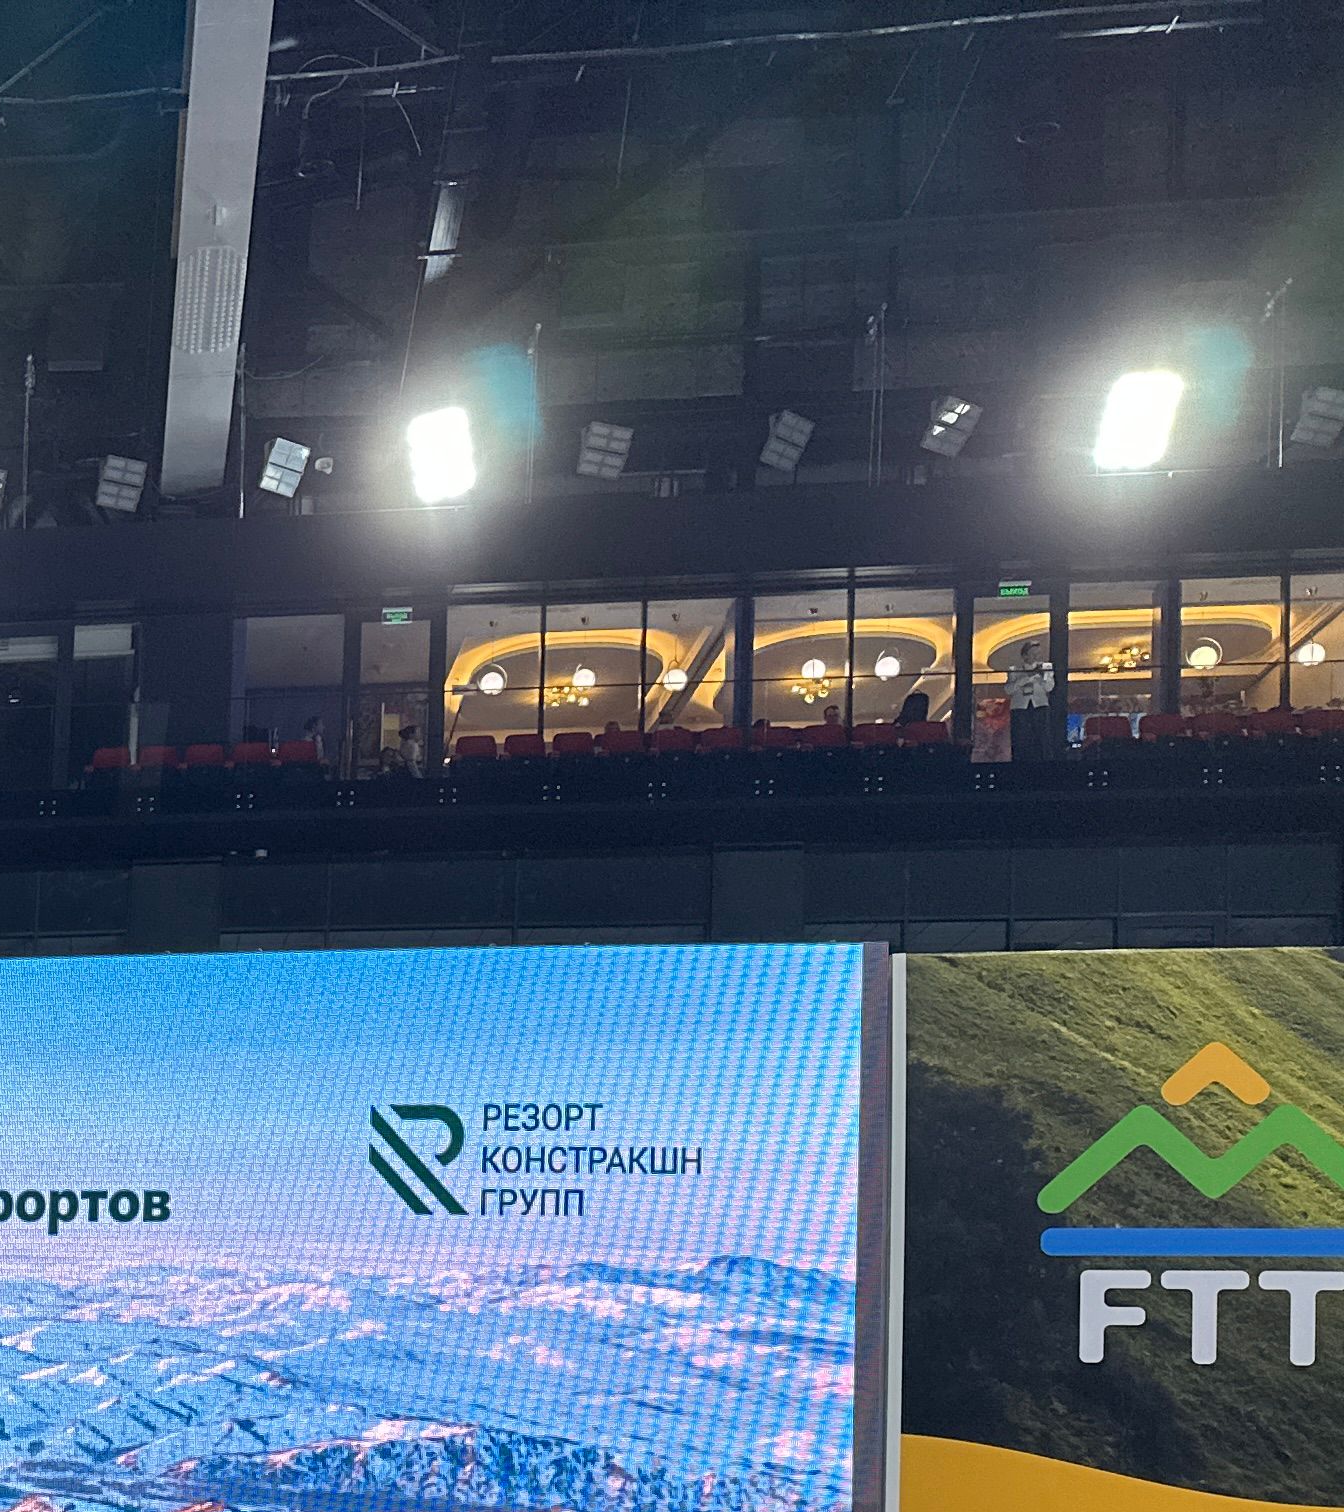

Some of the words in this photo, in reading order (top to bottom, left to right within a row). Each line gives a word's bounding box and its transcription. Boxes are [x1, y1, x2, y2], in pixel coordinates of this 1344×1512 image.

[482, 1104, 602, 1131] РЕЗОРТ
[481, 1146, 702, 1175] КОНСТРАКШН
[480, 1189, 584, 1216] ГРУПП
[1079, 1269, 1344, 1365] FTT
